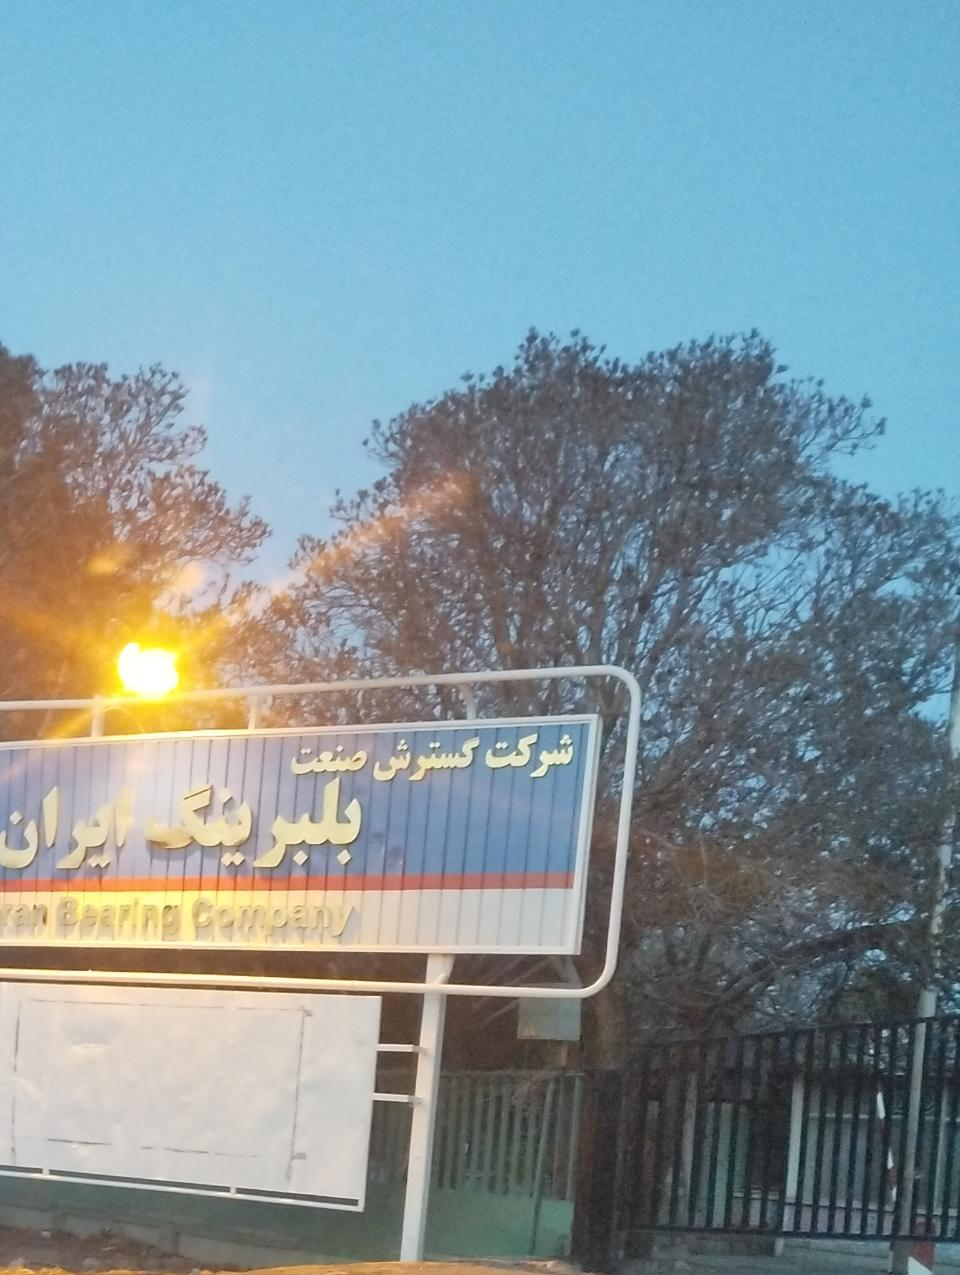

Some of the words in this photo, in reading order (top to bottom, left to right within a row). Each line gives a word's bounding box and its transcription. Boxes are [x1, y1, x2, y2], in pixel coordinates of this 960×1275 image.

[291, 745, 368, 775] صنعت
[373, 737, 481, 781] گسترش
[484, 733, 574, 778] شرکت
[145, 776, 362, 868] بلبرینگ
[55, 895, 183, 935] Bearing
[191, 895, 355, 938] Company
